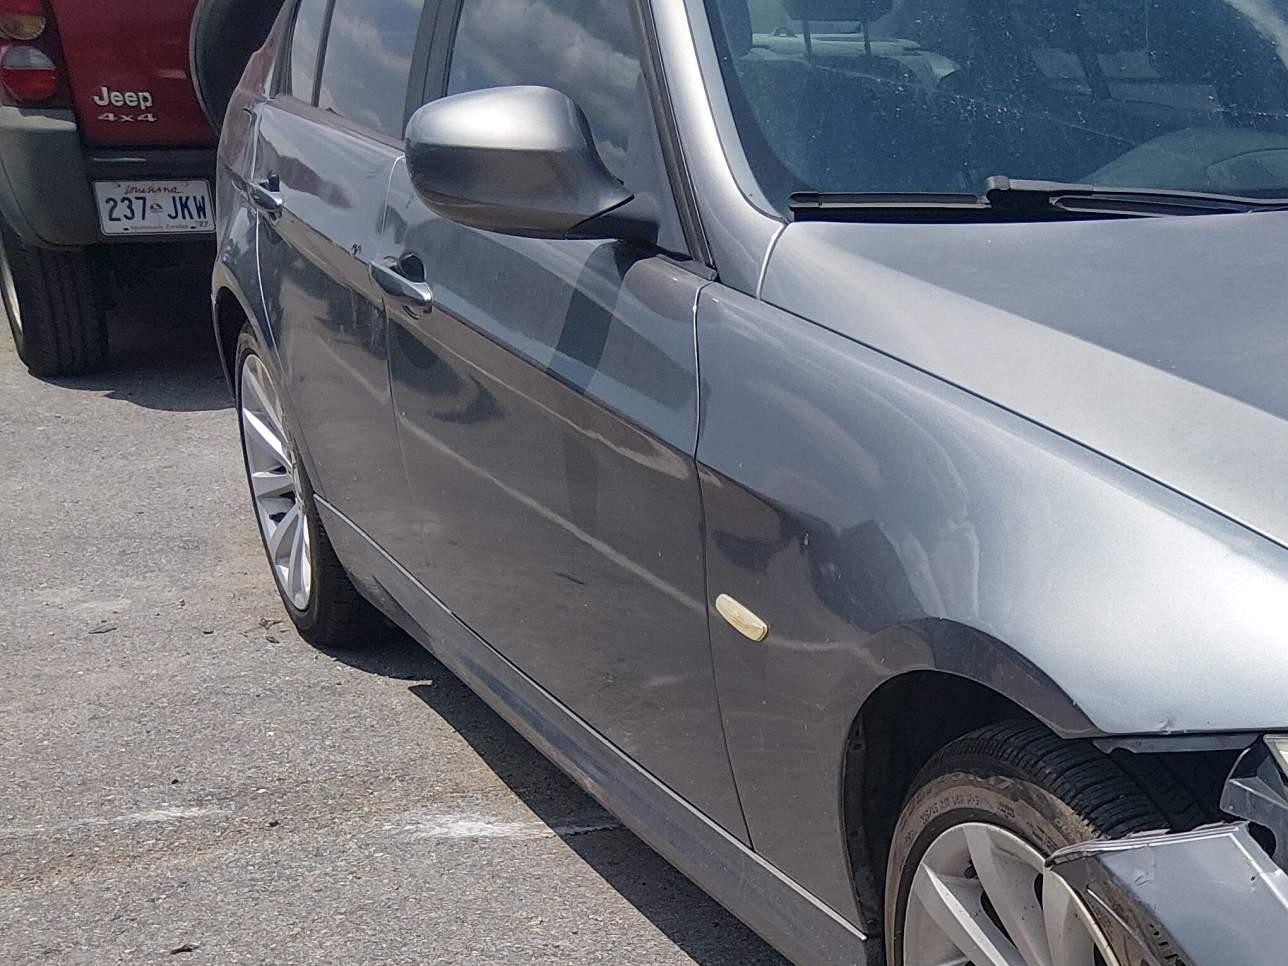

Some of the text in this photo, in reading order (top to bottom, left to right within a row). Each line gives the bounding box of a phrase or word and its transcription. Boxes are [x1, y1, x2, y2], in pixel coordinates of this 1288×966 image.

[92, 86, 153, 110] Jeep
[97, 112, 157, 122] 4x4
[125, 184, 183, 195] Louisiana
[105, 195, 206, 222] 237 JKW
